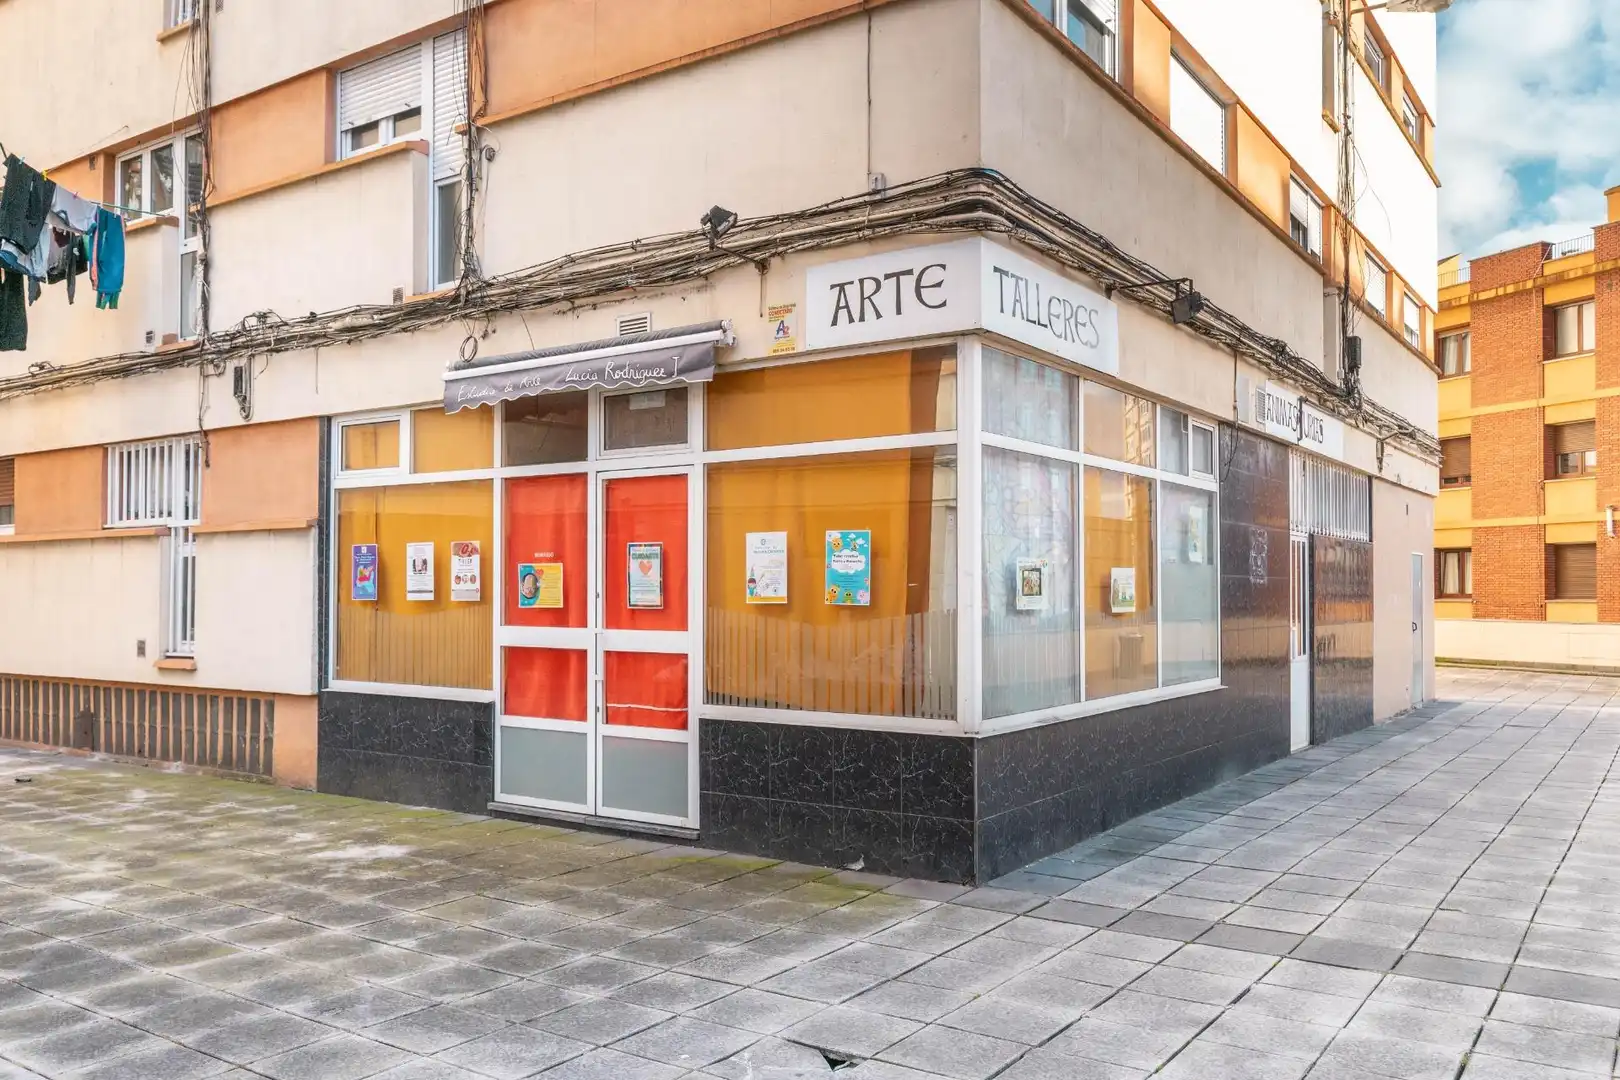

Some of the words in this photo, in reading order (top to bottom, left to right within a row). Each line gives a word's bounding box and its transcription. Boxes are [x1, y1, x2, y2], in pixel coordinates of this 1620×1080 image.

[830, 264, 947, 327] ARTE
[993, 265, 1099, 349] TALLERES
[458, 384, 496, 402] Estudio
[520, 375, 541, 389] Arte
